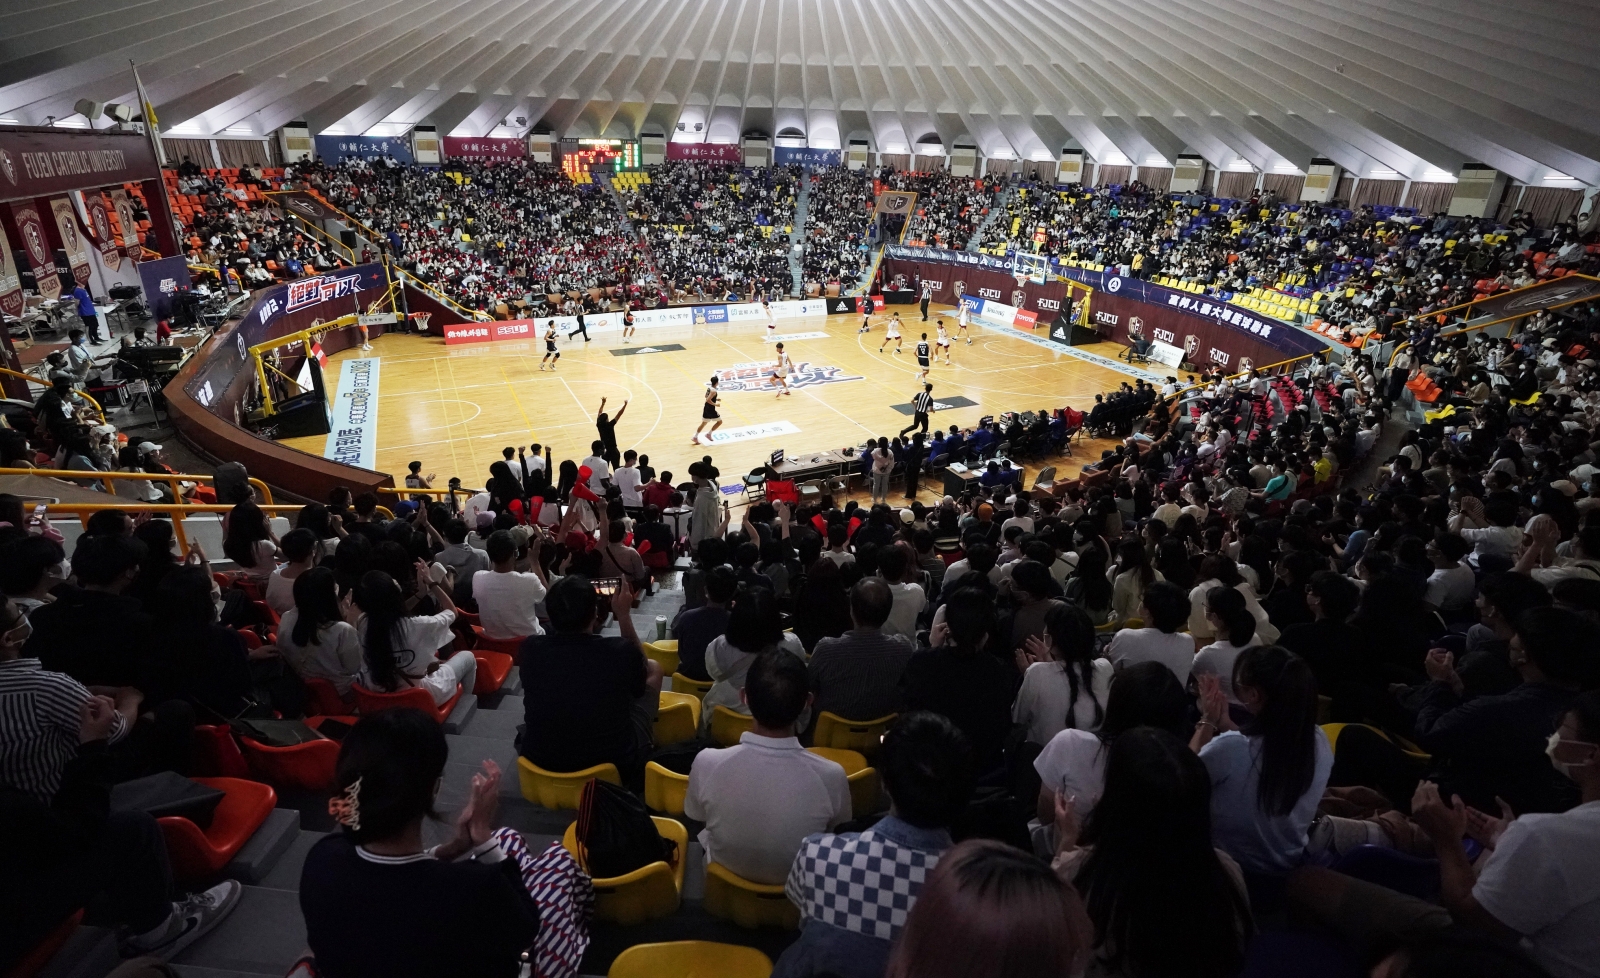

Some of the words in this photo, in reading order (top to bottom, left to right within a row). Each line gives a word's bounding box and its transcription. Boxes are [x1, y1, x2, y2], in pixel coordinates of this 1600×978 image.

[51, 150, 91, 176] CATHOLIC
[88, 149, 127, 172] UNIVERSITY
[978, 287, 1002, 299] FJCU
[1037, 297, 1061, 310] FJCU
[1016, 313, 1035, 323] TOYOTA
[1095, 310, 1119, 325] FJCU
[309, 323, 339, 336] GARED
[1153, 327, 1175, 343] FJCU
[1209, 347, 1231, 365] FJCU
